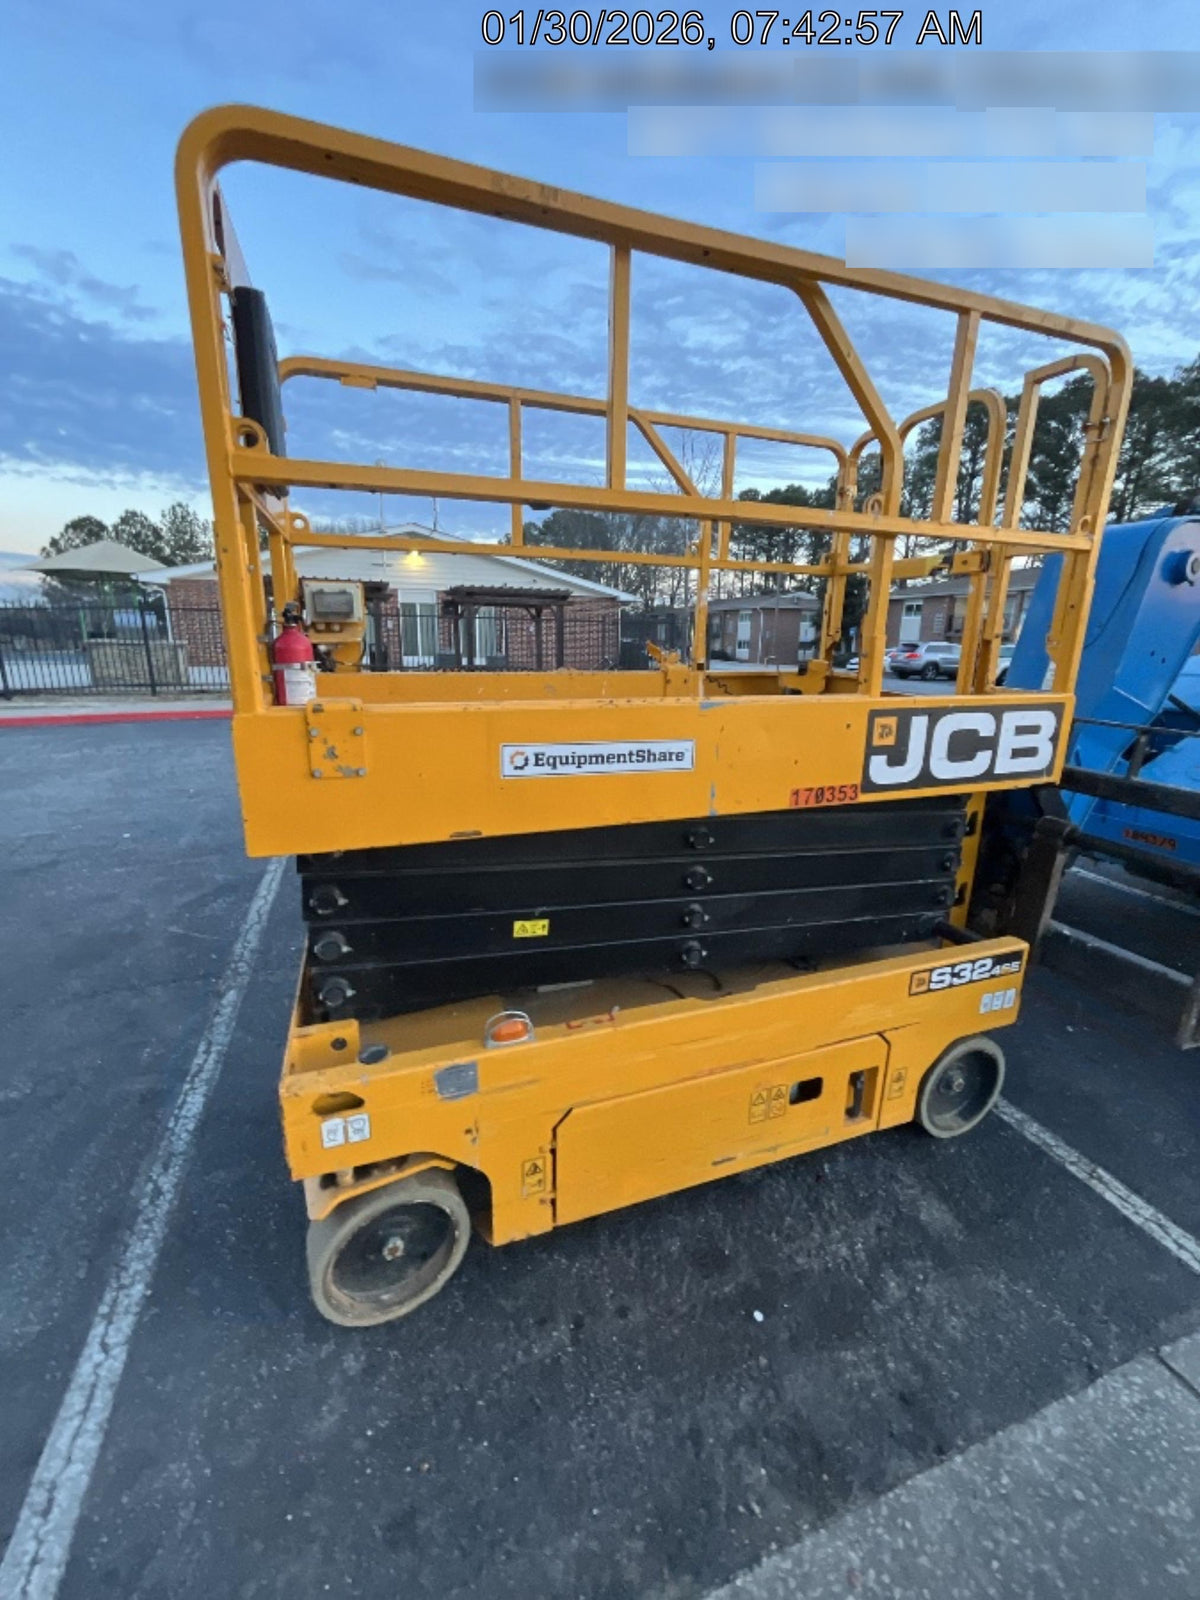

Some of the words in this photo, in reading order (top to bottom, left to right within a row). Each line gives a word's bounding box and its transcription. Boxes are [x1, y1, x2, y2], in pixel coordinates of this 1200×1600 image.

[533, 748, 685, 770] EquipmentShare
[869, 710, 1057, 785] JCB
[791, 783, 858, 806] 170353
